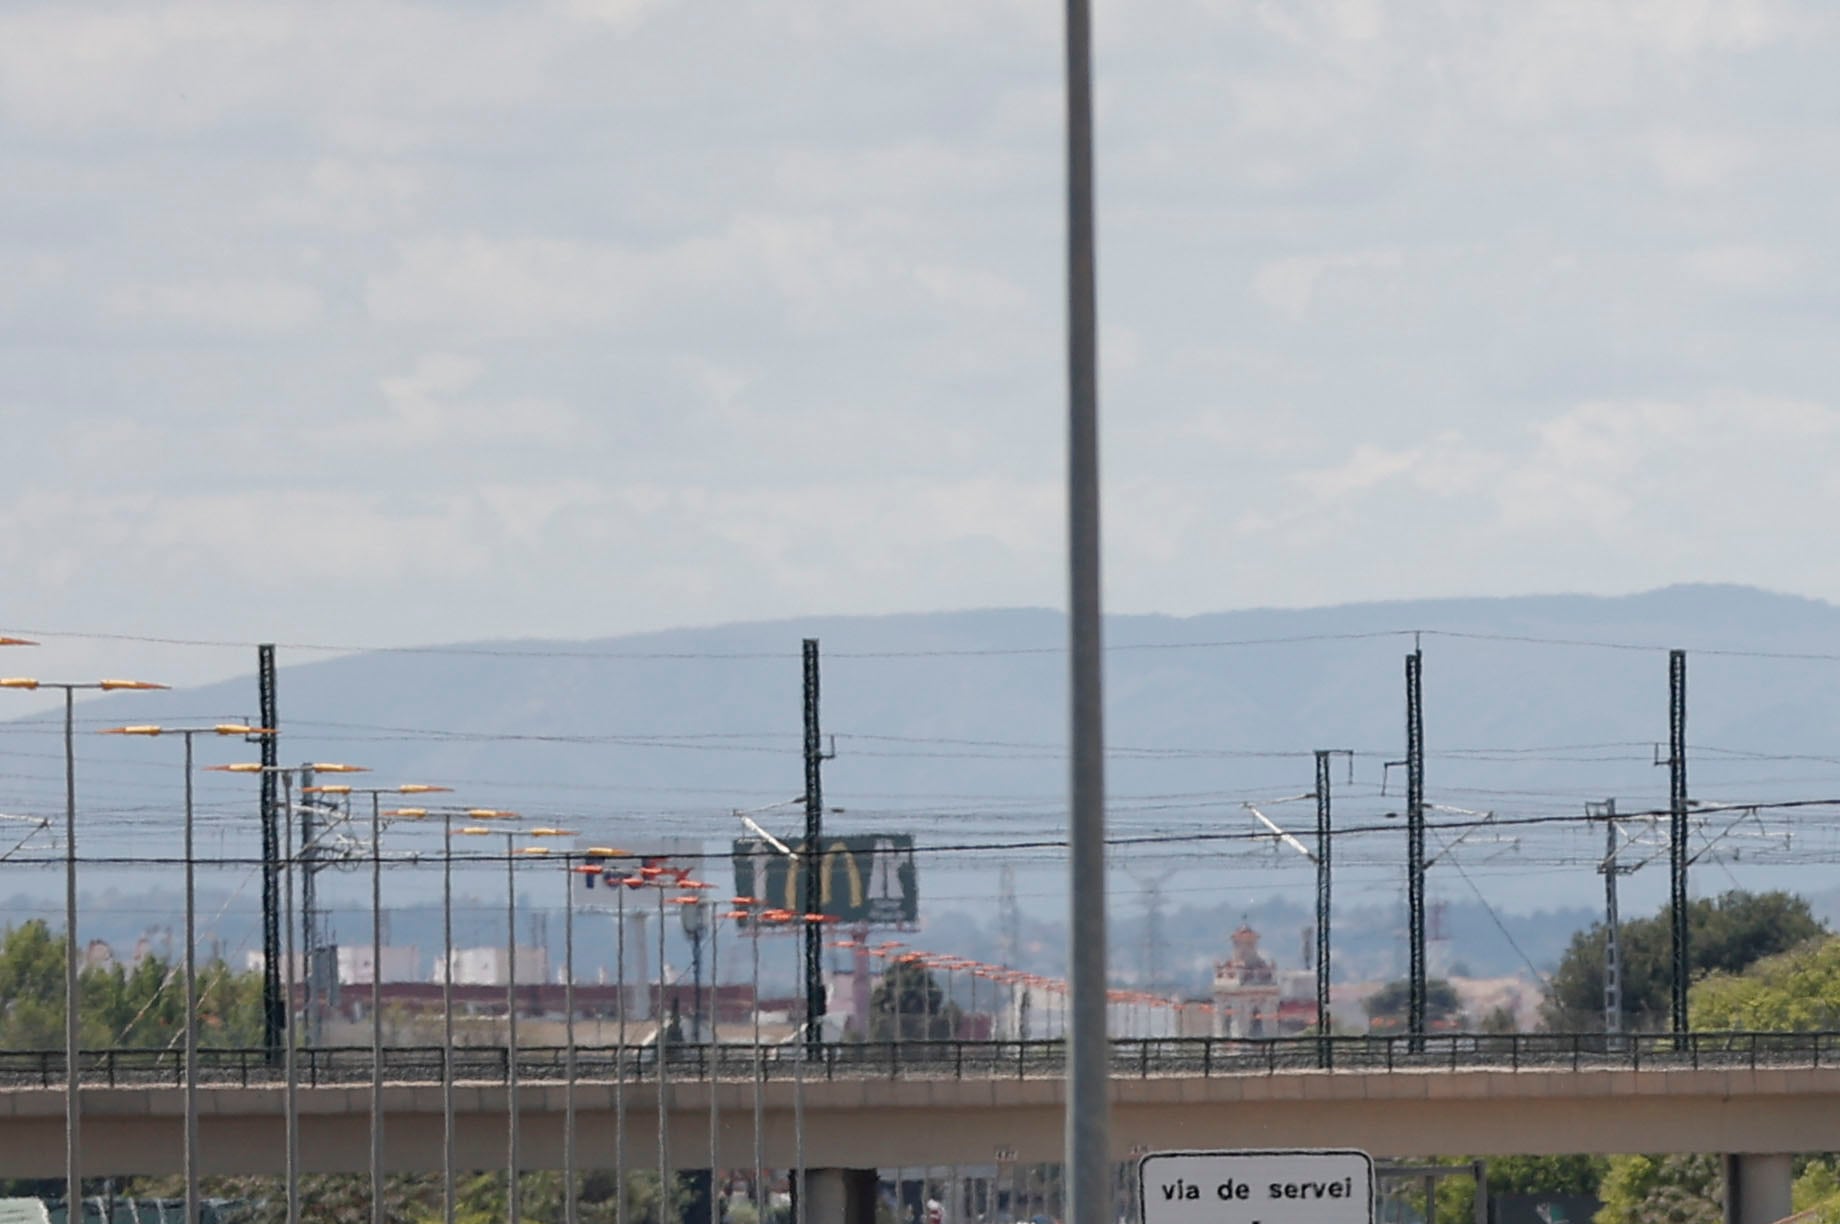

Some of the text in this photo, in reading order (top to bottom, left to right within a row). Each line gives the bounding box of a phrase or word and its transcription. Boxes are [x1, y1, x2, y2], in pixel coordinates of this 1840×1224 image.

[1161, 1176, 1353, 1201] via de servei
